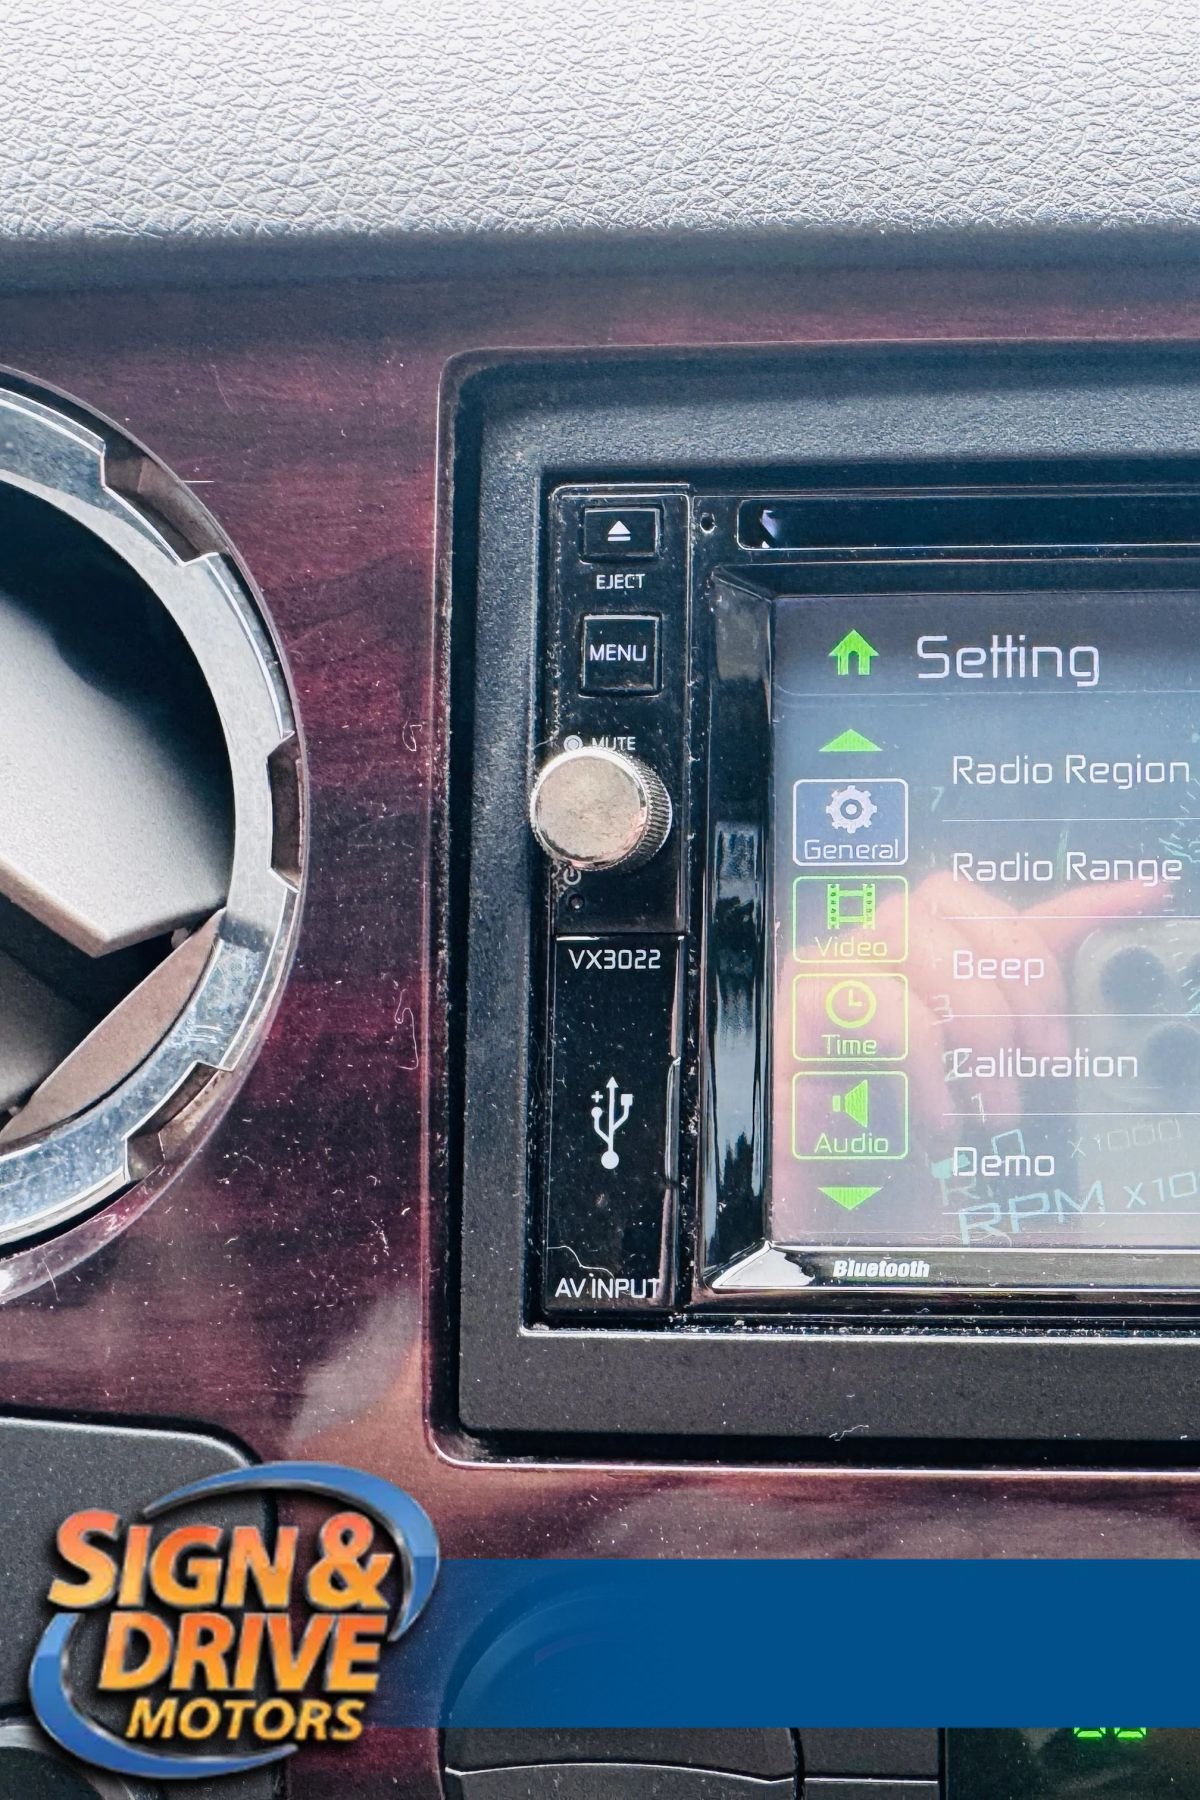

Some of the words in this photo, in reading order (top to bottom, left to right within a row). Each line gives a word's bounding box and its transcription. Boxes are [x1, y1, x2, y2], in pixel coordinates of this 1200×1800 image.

[596, 573, 646, 590] EJECT
[589, 643, 648, 662] MENU
[916, 634, 1101, 687] Setting
[591, 735, 637, 751] MUTE
[952, 755, 1054, 785] Radio
[1064, 754, 1191, 790] Region
[803, 840, 900, 861] General
[952, 852, 1054, 882] Radio
[1065, 853, 1184, 887] Range
[814, 936, 888, 959] Video
[567, 949, 662, 970] VX3022
[952, 951, 1045, 986] Beep
[820, 1034, 879, 1056] Time
[951, 1048, 1139, 1079] Calibration
[814, 1133, 890, 1155] Audio
[952, 1146, 1056, 1177] Demo
[957, 1179, 1106, 1246] RPM
[832, 1259, 931, 1279] Bluetooth
[554, 1277, 584, 1299] AV
[590, 1276, 662, 1299] INPUT
